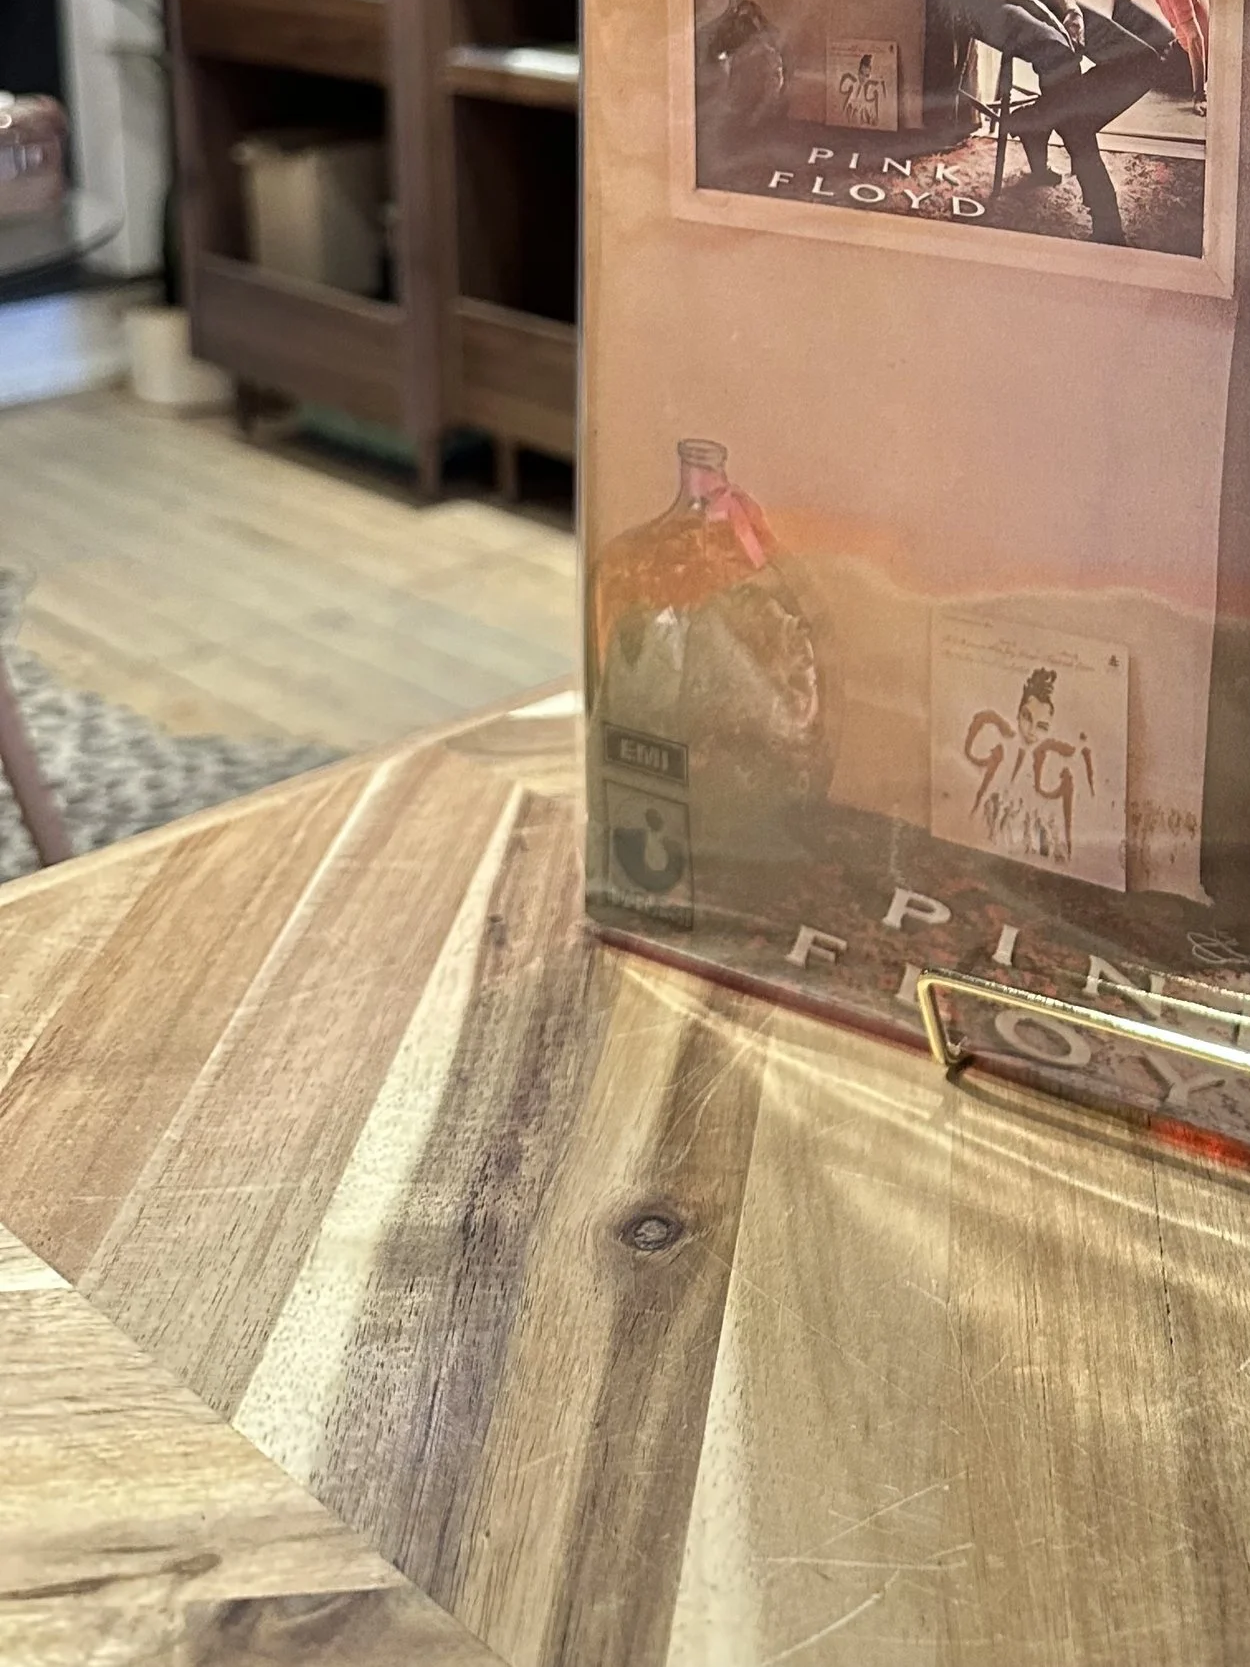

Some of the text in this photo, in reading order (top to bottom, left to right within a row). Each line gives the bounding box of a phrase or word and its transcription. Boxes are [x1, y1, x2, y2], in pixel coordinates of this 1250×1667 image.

[807, 146, 961, 187] PINK
[769, 170, 986, 218] FLOYD
[620, 738, 669, 771] EMI
